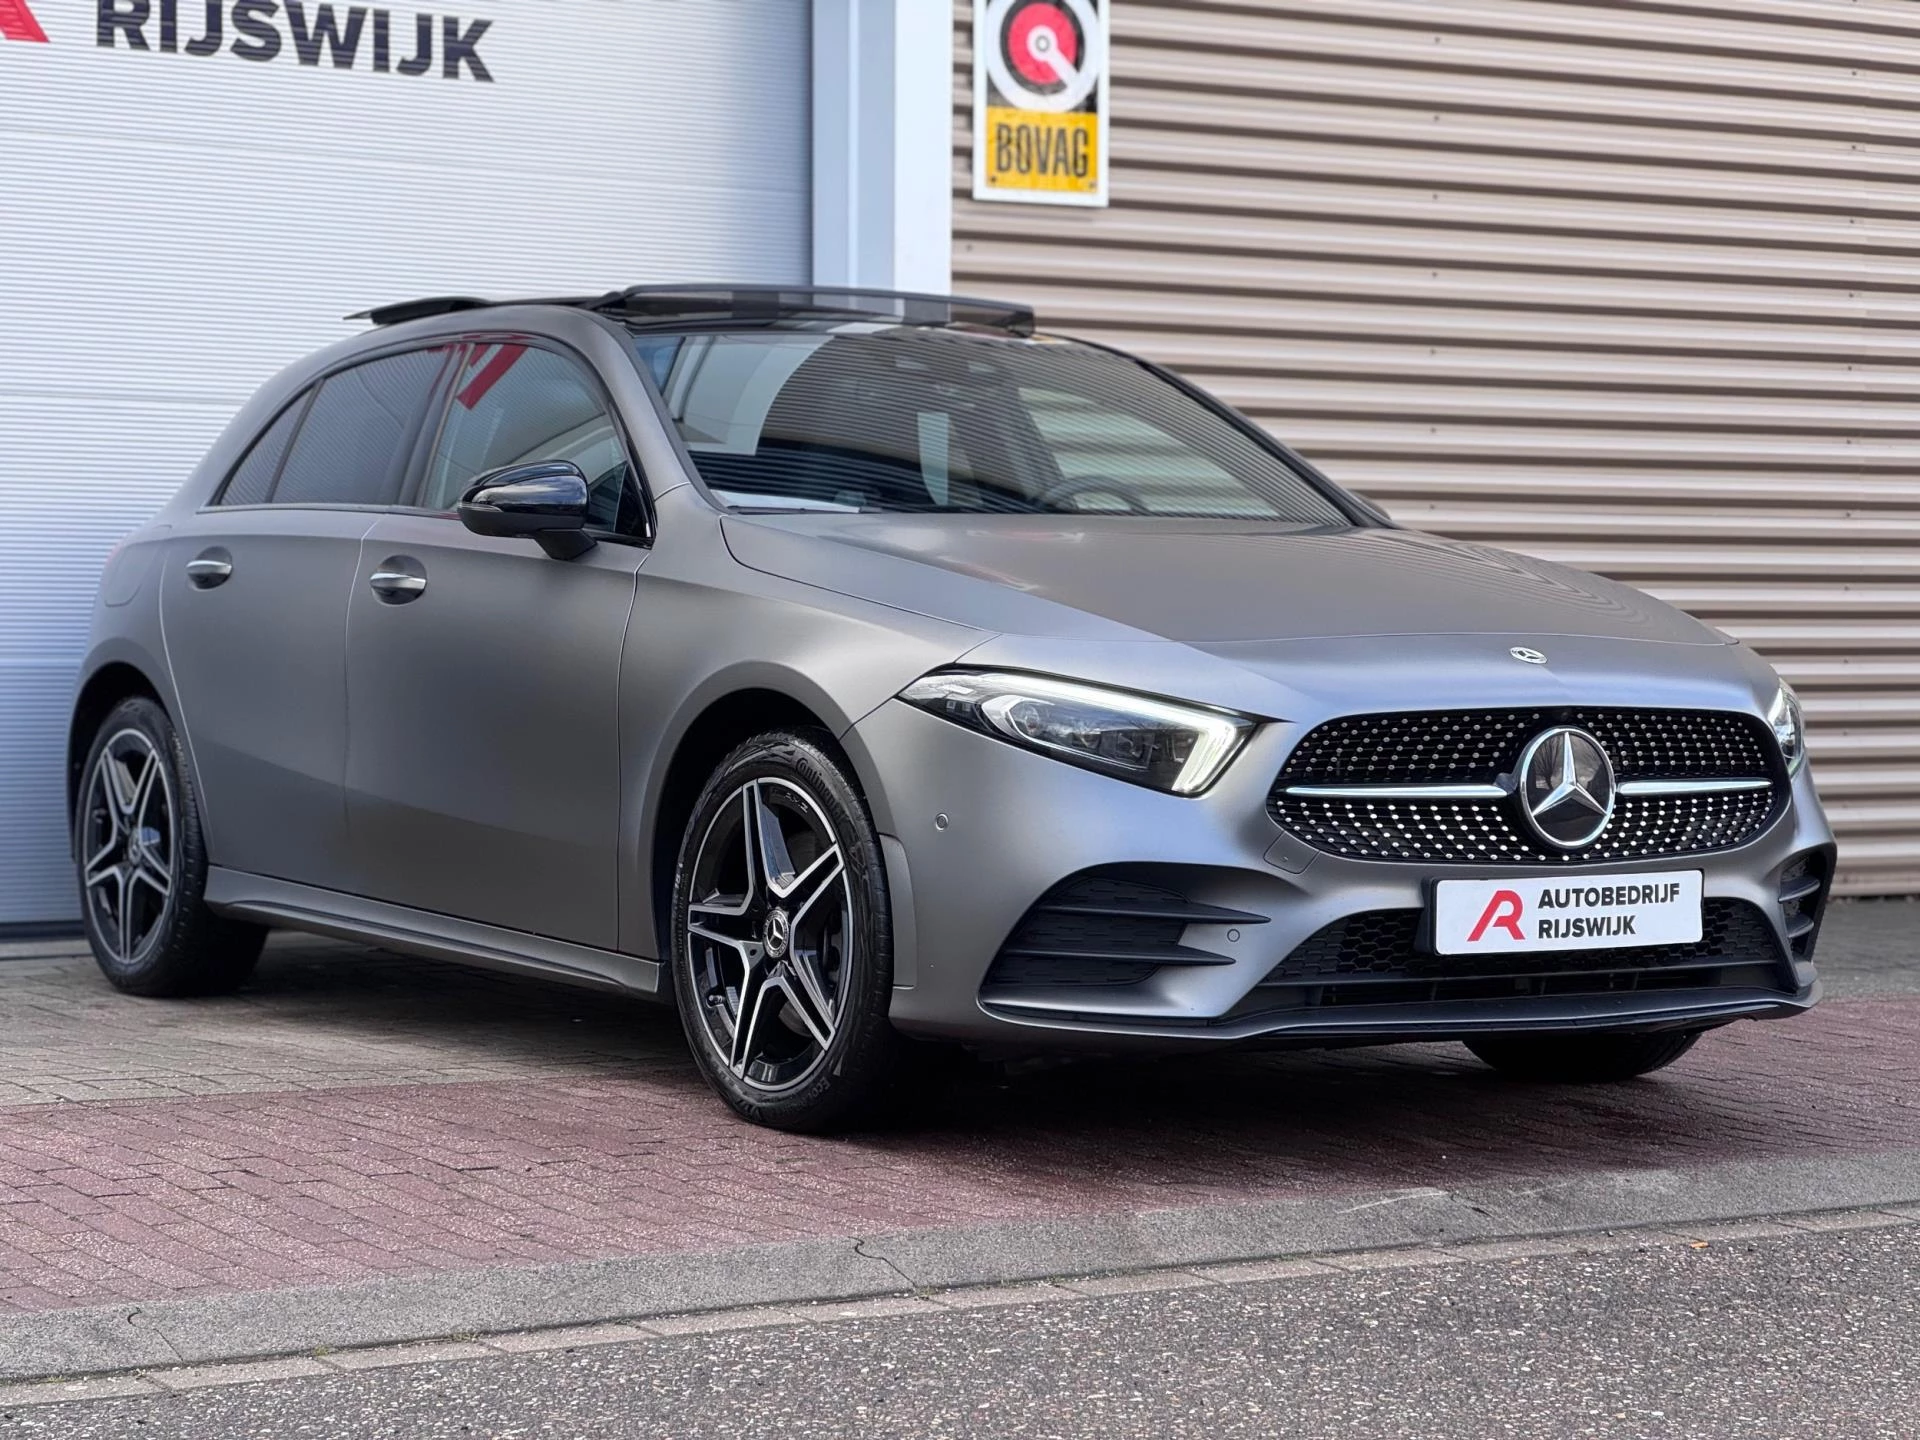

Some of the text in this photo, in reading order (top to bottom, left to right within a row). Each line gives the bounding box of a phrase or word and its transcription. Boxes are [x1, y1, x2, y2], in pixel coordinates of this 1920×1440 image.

[96, 0, 495, 83] RIJSWIJK
[995, 122, 1089, 178] BOVAG
[1538, 883, 1680, 909] AUTOBEDRIJF
[1538, 915, 1636, 939] RIJSWIJK
